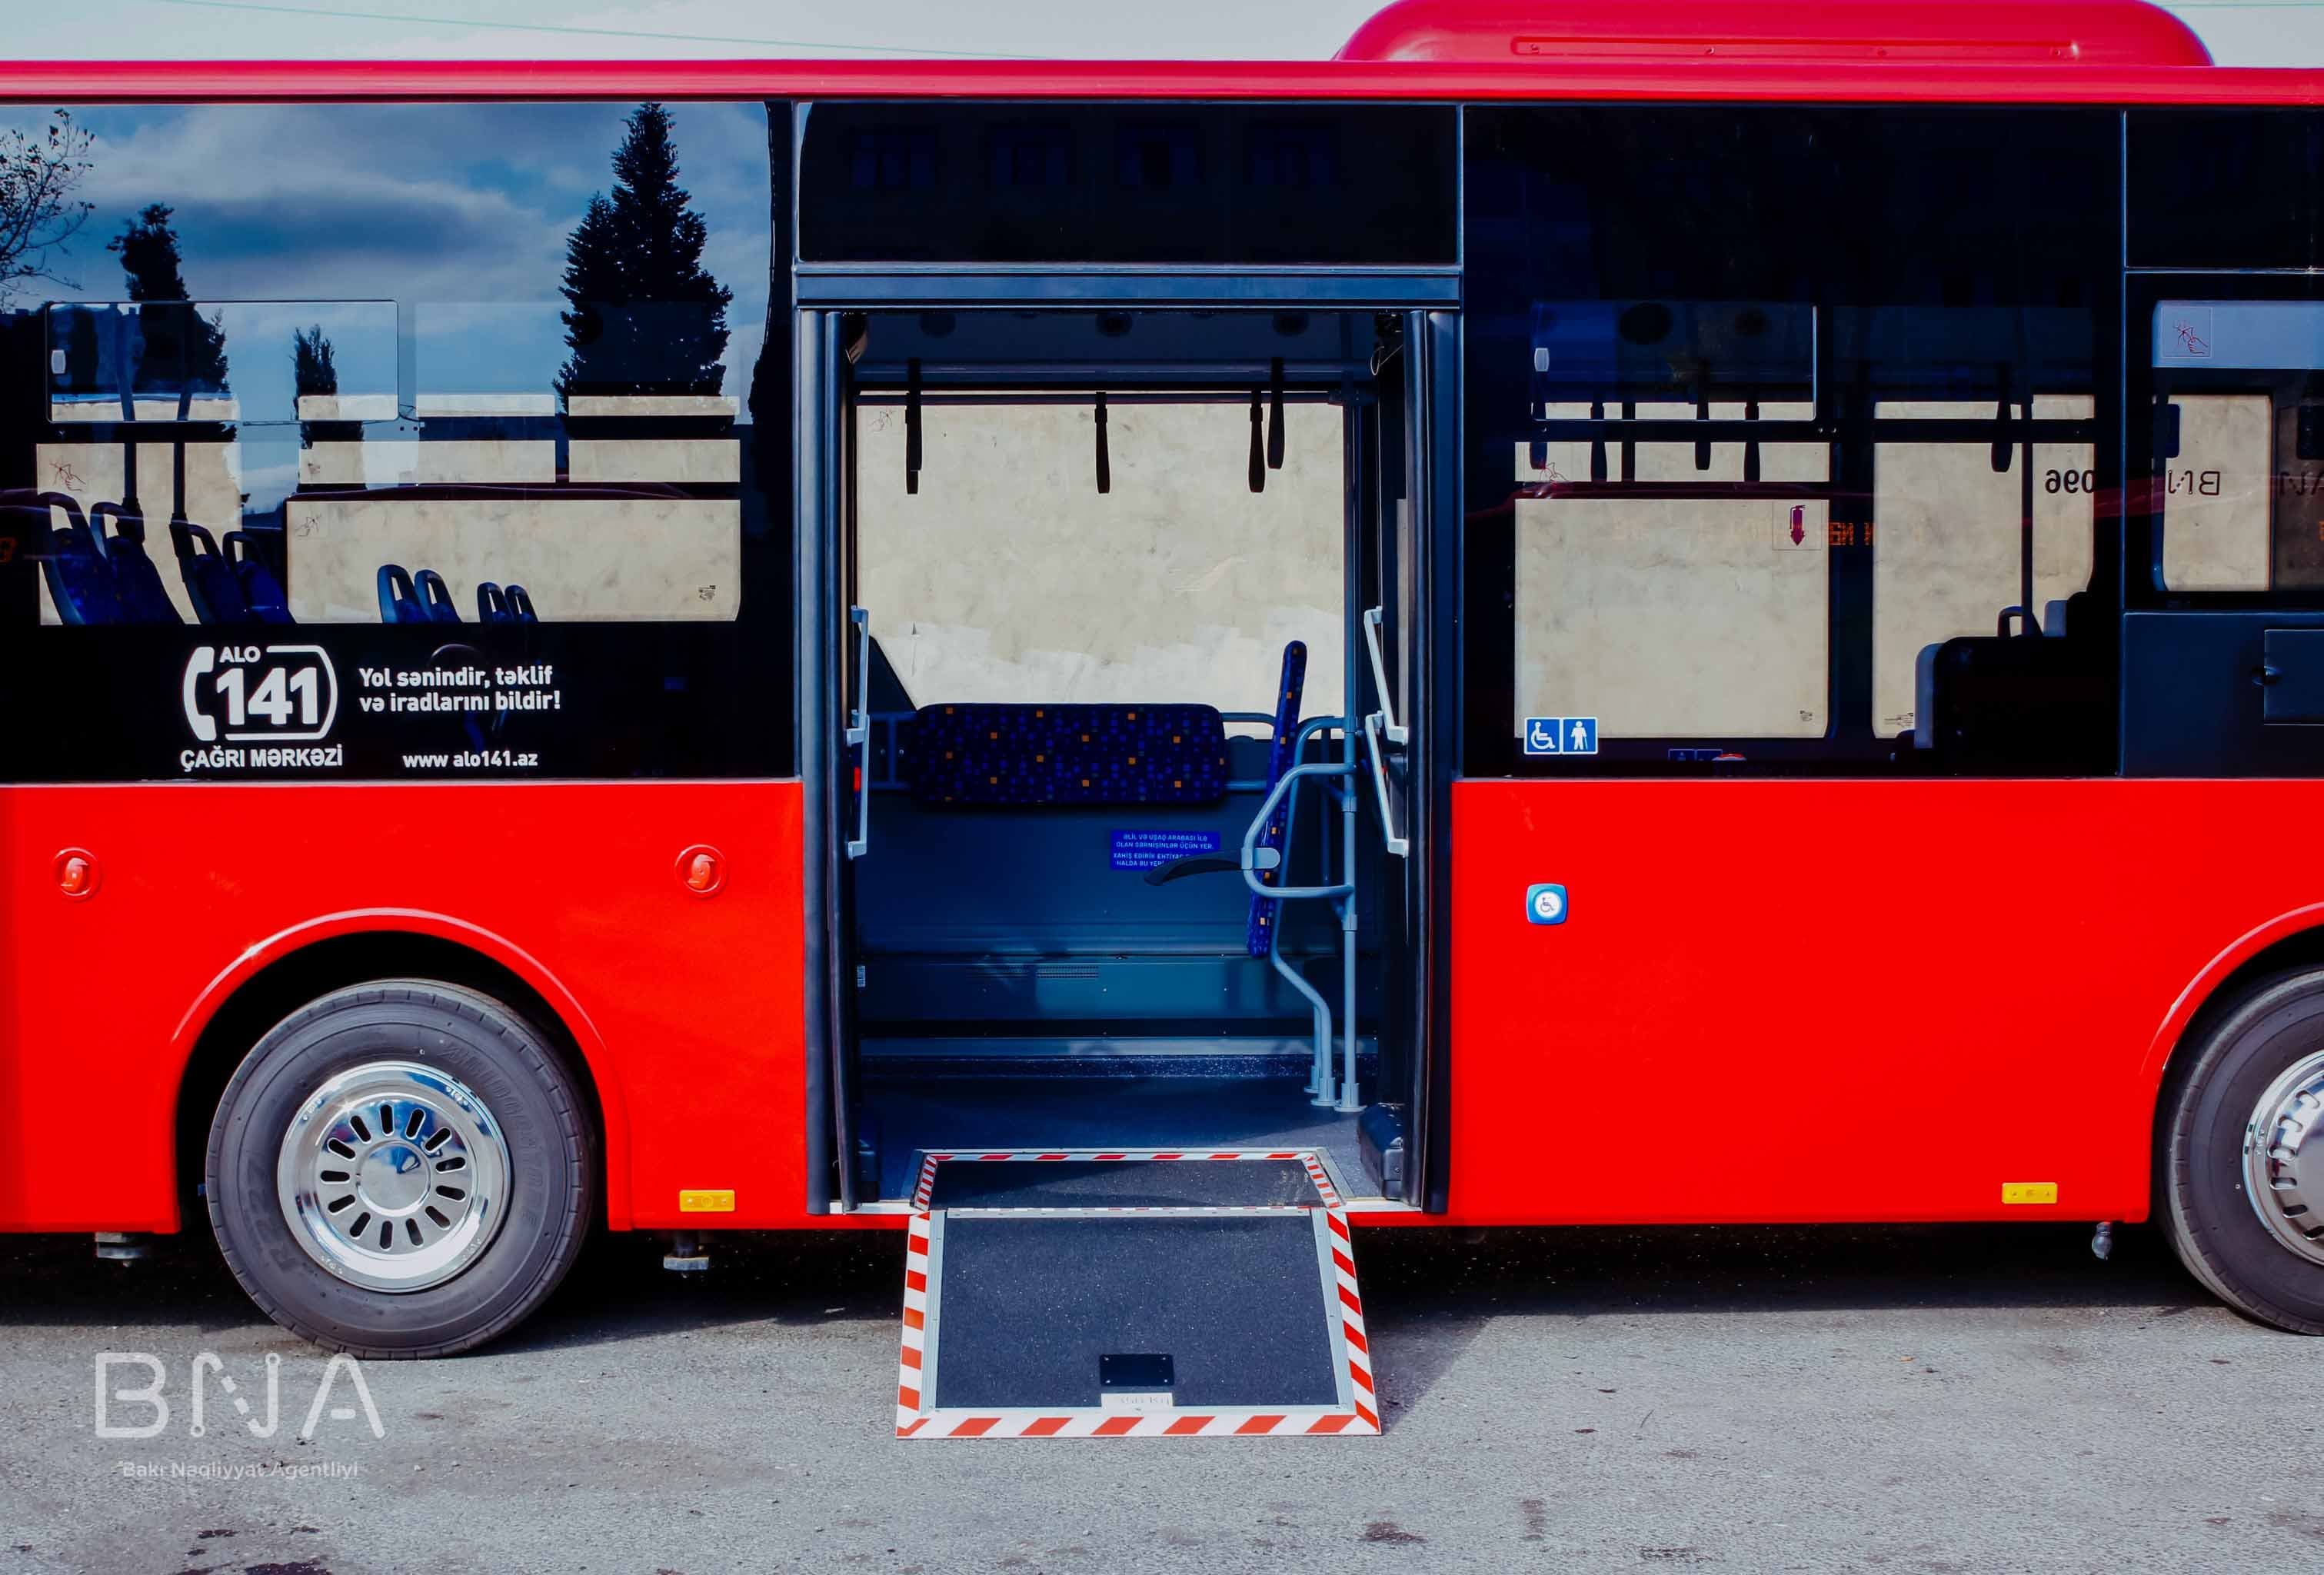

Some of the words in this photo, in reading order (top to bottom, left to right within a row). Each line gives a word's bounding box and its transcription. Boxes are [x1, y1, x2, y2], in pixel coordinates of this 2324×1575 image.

[219, 645, 261, 663] ALO
[358, 667, 393, 688] Yol
[396, 666, 491, 689] sənindir,
[494, 664, 553, 686] təklif
[216, 667, 318, 725] 141
[359, 696, 385, 712] və
[390, 691, 491, 712] iradlarını
[495, 690, 561, 710] bildir!
[180, 745, 245, 773] ÇAĞRI
[250, 743, 343, 768] MƏRKƏZİ
